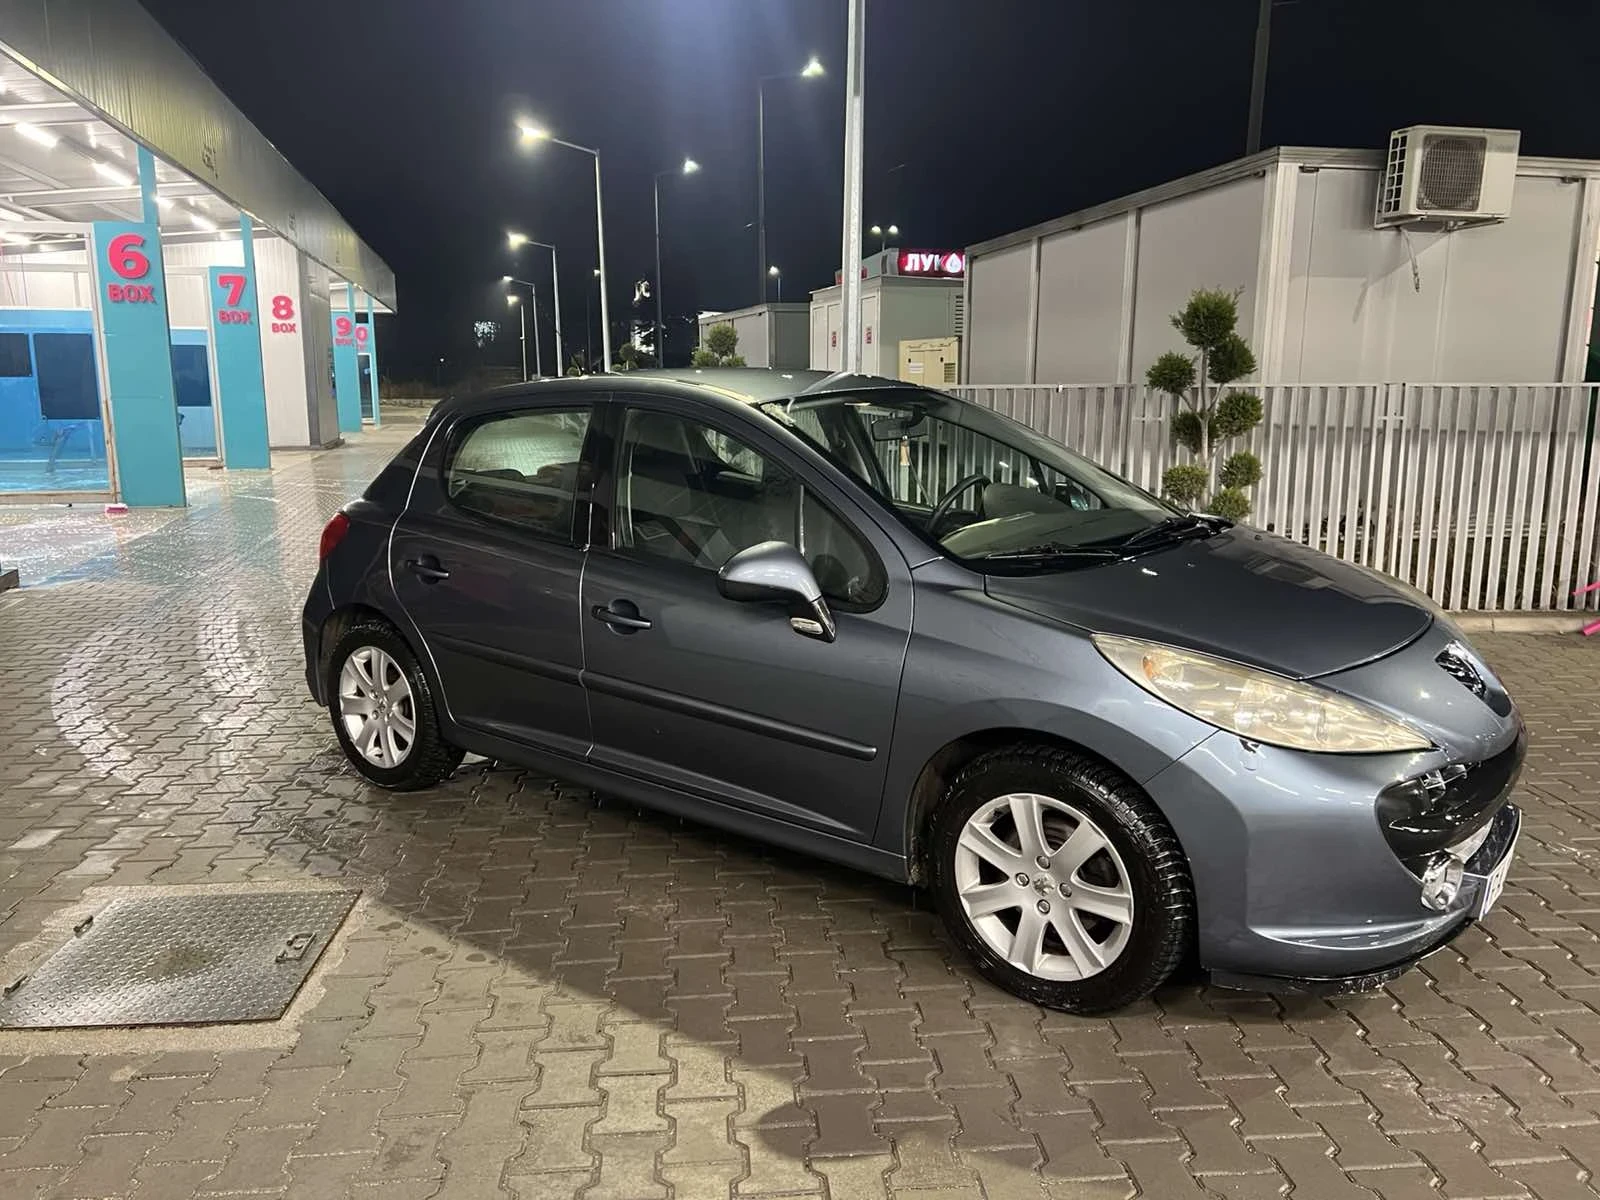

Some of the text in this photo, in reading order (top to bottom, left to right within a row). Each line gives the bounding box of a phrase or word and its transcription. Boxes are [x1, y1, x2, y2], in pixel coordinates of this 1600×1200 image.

[107, 232, 150, 279] 6
[904, 253, 966, 273] ЛУКО
[107, 283, 155, 303] BOX
[218, 274, 246, 306] 7
[218, 310, 251, 324] BOX
[272, 295, 294, 320] 8
[271, 322, 296, 333] BOX
[335, 316, 352, 336] 9
[354, 326, 368, 342] 0
